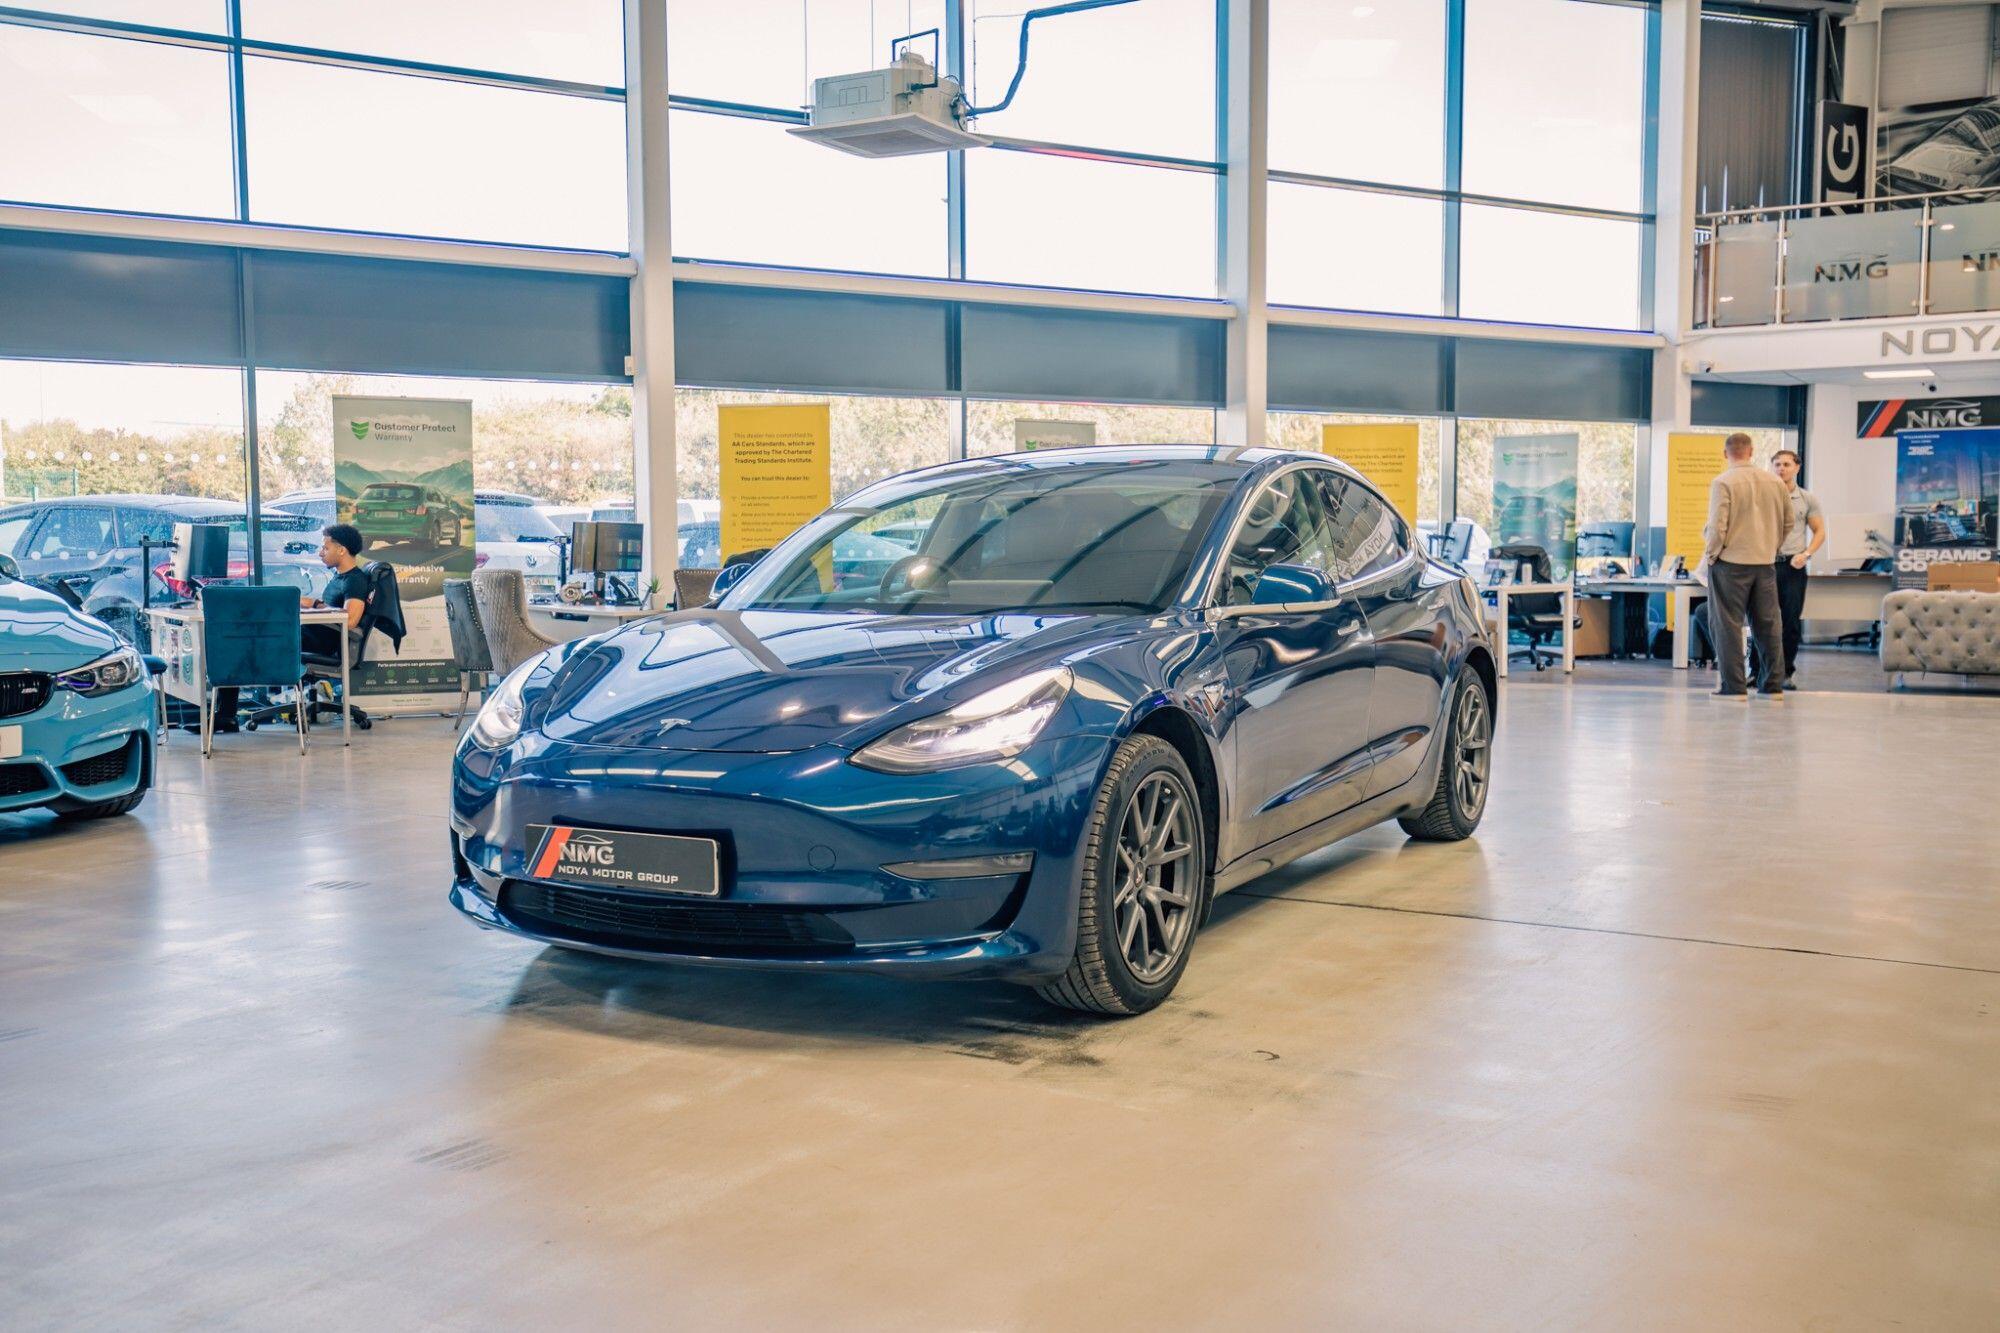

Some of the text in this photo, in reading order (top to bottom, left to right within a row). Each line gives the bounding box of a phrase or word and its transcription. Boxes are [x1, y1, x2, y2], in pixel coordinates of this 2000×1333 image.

[1814, 261, 1889, 283] NMG
[1882, 325, 2000, 357] NOY
[1906, 407, 1982, 429] NMG
[374, 422, 456, 432] Customer Protect
[375, 433, 413, 442] Warranty
[1898, 548, 1992, 561] CERAMIC
[1898, 560, 1928, 572] CO
[396, 575, 430, 585] arranty
[559, 842, 615, 865] NMG
[558, 865, 679, 884] NOYA MOTOR GROUP
